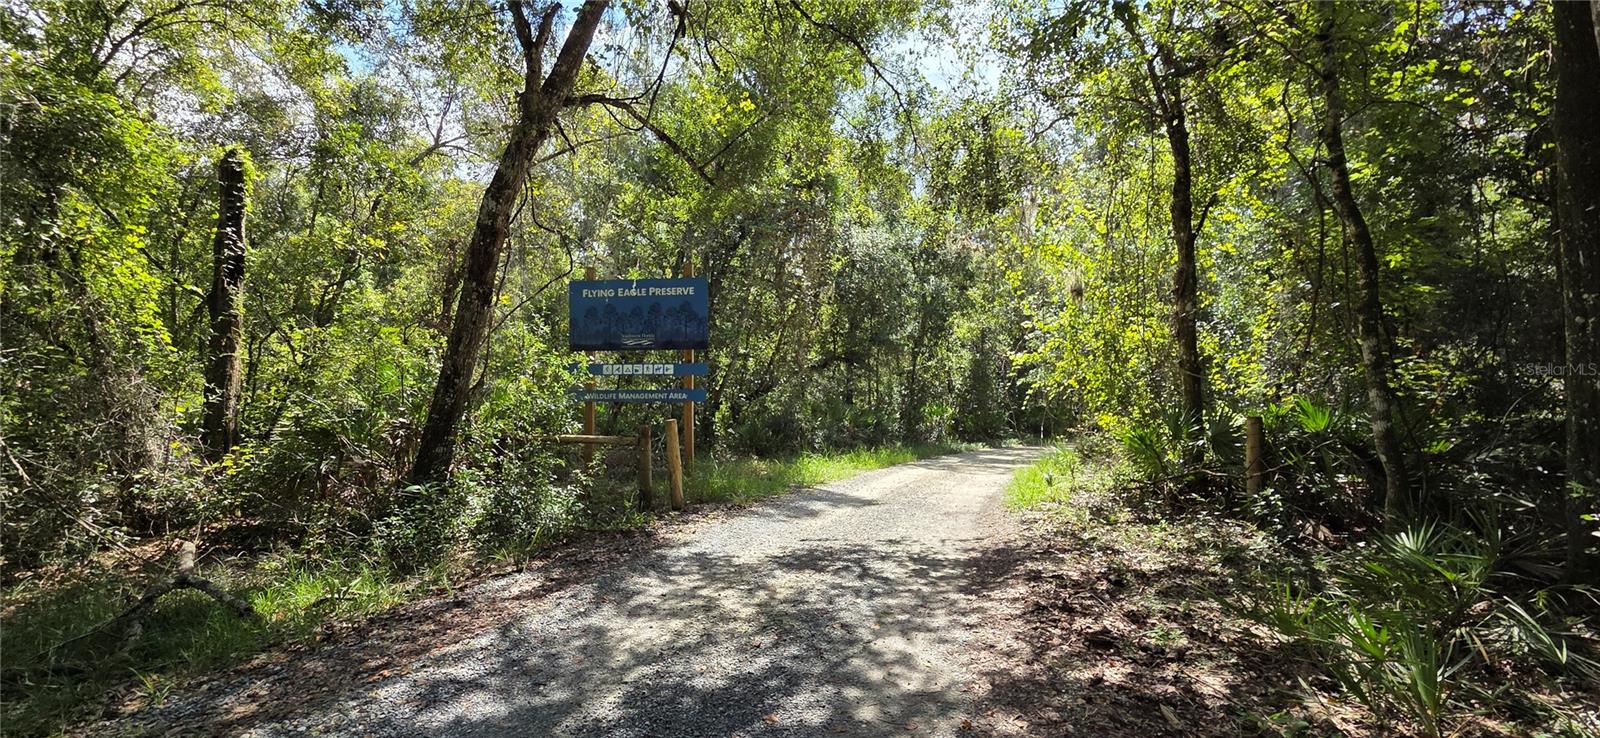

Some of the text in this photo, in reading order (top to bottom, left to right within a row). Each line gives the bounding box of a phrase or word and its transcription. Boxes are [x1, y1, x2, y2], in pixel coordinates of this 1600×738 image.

[582, 286, 695, 298] FLYING EAGLE PRESERVE
[618, 392, 668, 400] MANAGEMENT
[669, 392, 688, 400] AREA
